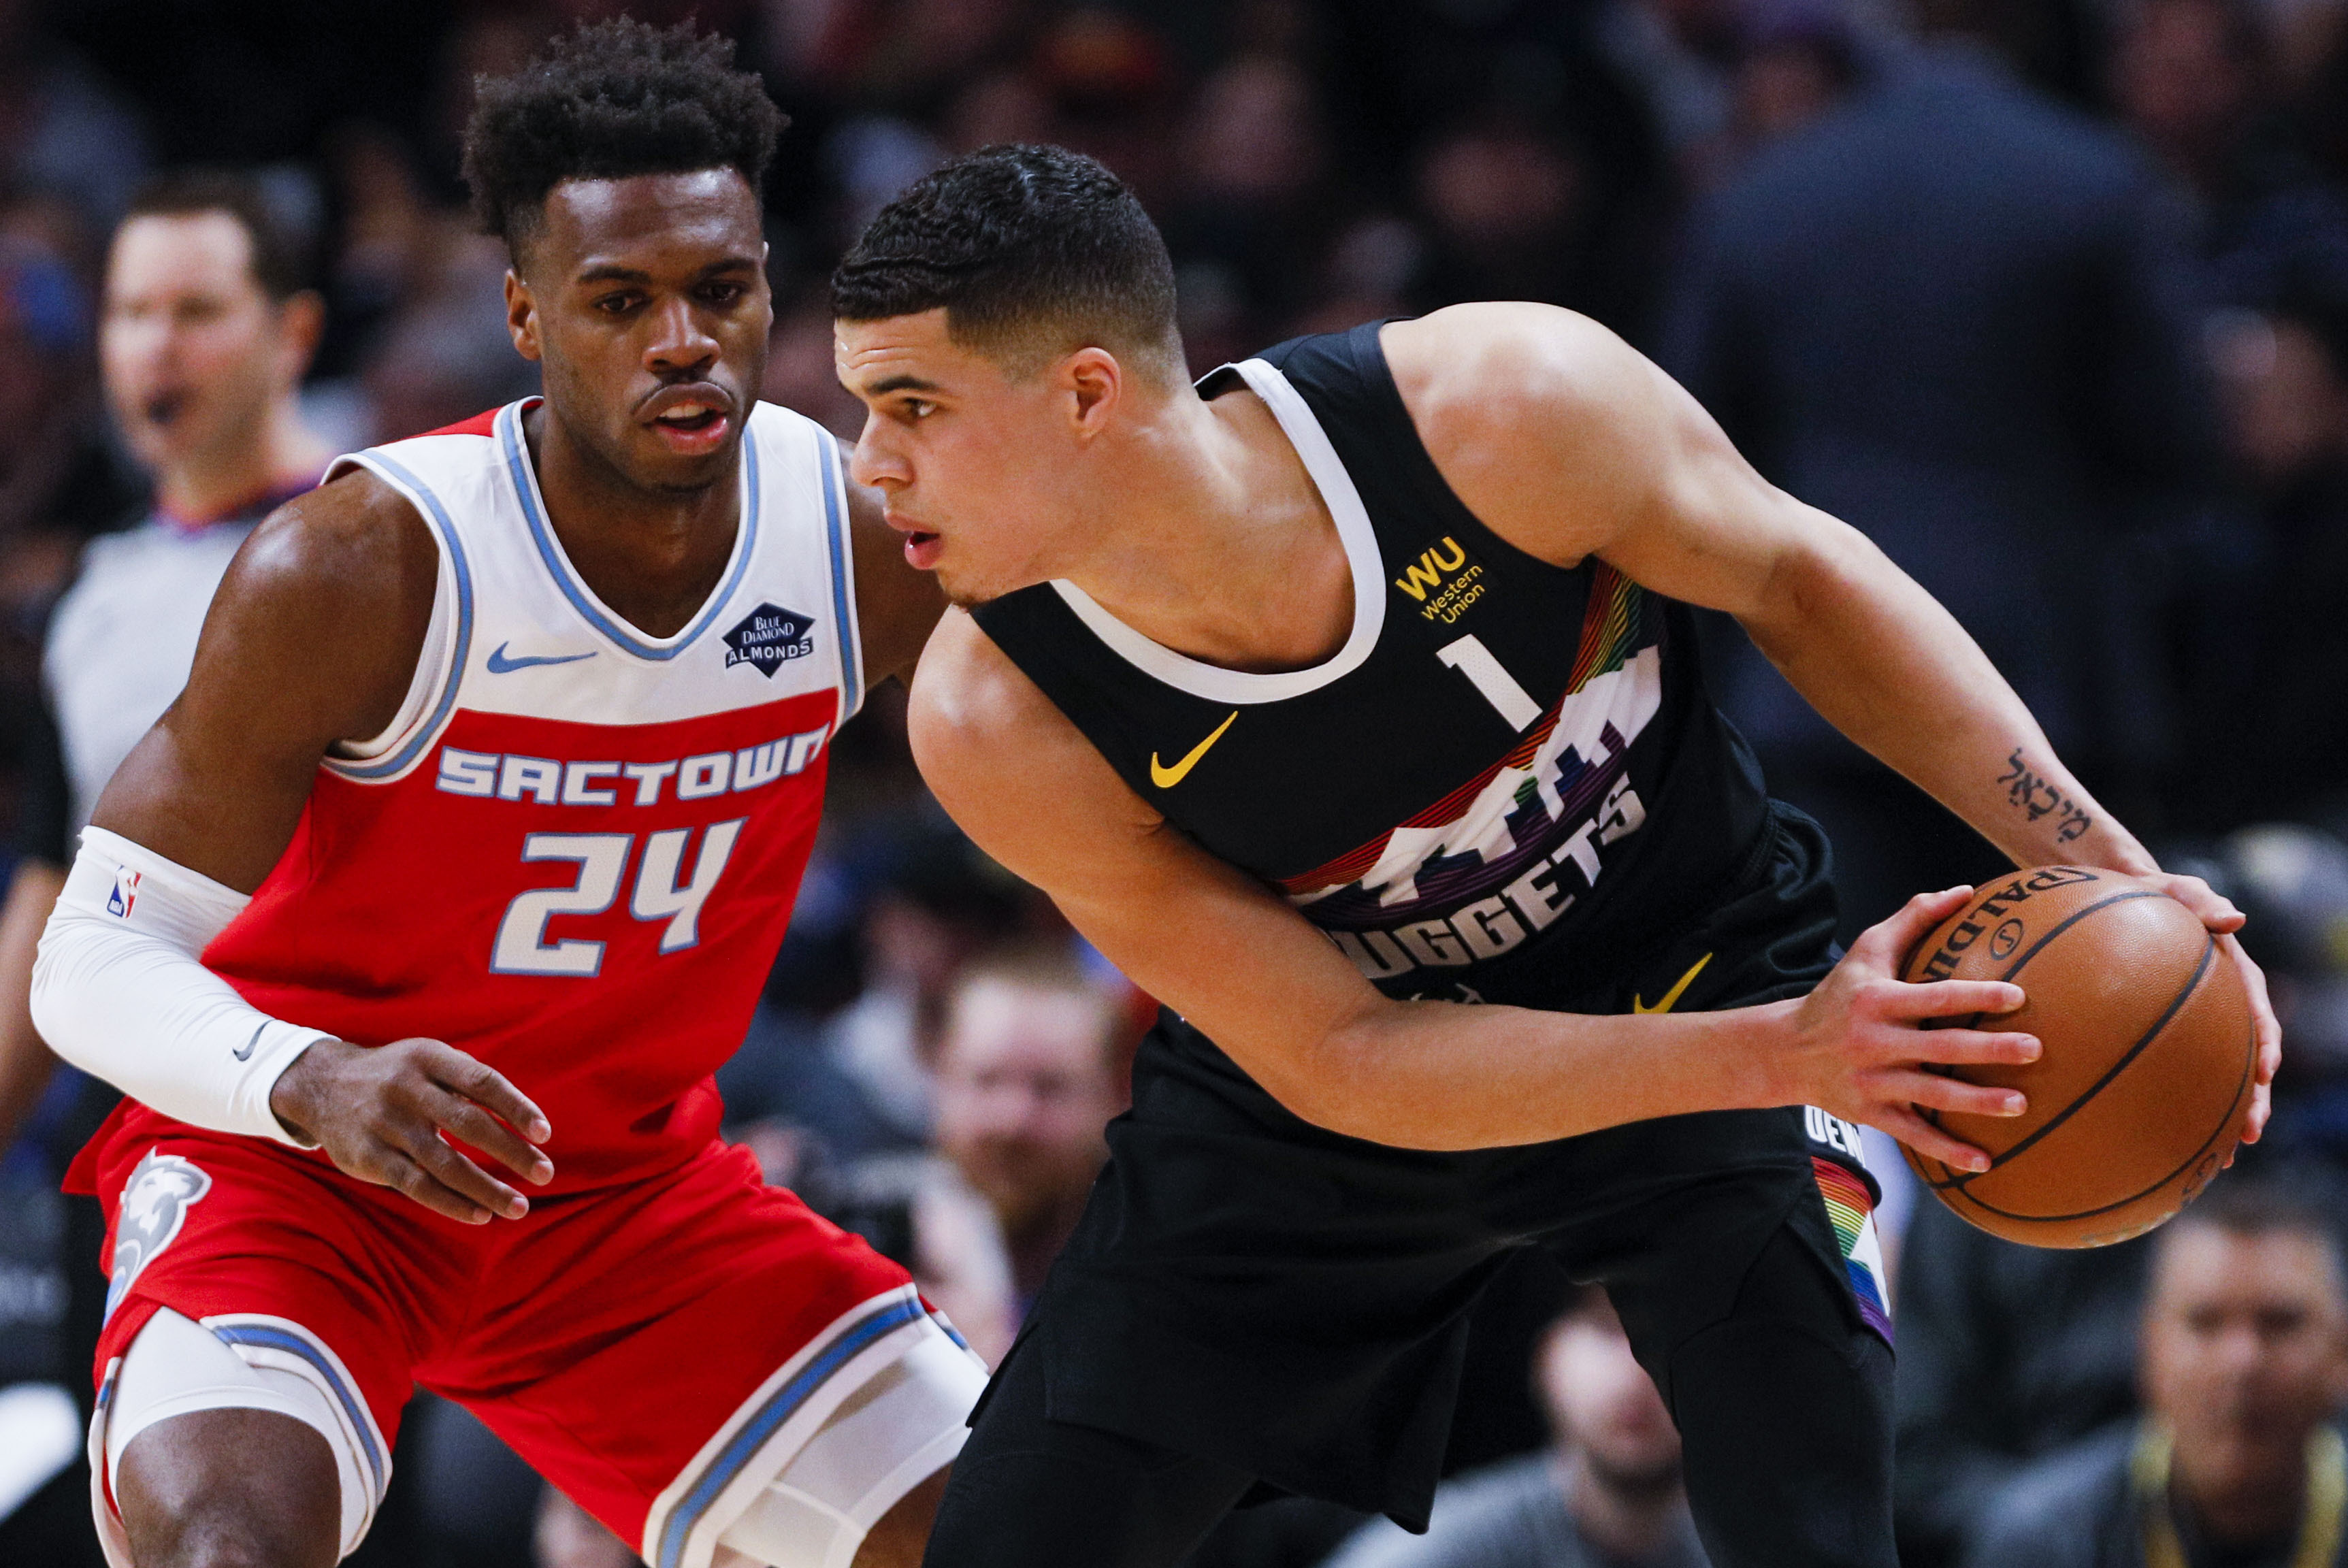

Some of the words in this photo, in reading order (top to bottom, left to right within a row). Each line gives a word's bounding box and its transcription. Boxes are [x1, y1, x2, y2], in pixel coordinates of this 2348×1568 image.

[1395, 536, 1466, 602] WU
[1420, 564, 1484, 621] Western
[743, 622, 795, 644] DIAMOND
[755, 615, 781, 631] BLUE
[1441, 583, 1486, 624] Union
[728, 640, 811, 665] ALMONDS
[1435, 633, 1544, 734] 1
[436, 721, 831, 806] SACTOWN
[488, 816, 749, 979] 24
[1320, 772, 1647, 979] UGGETS
